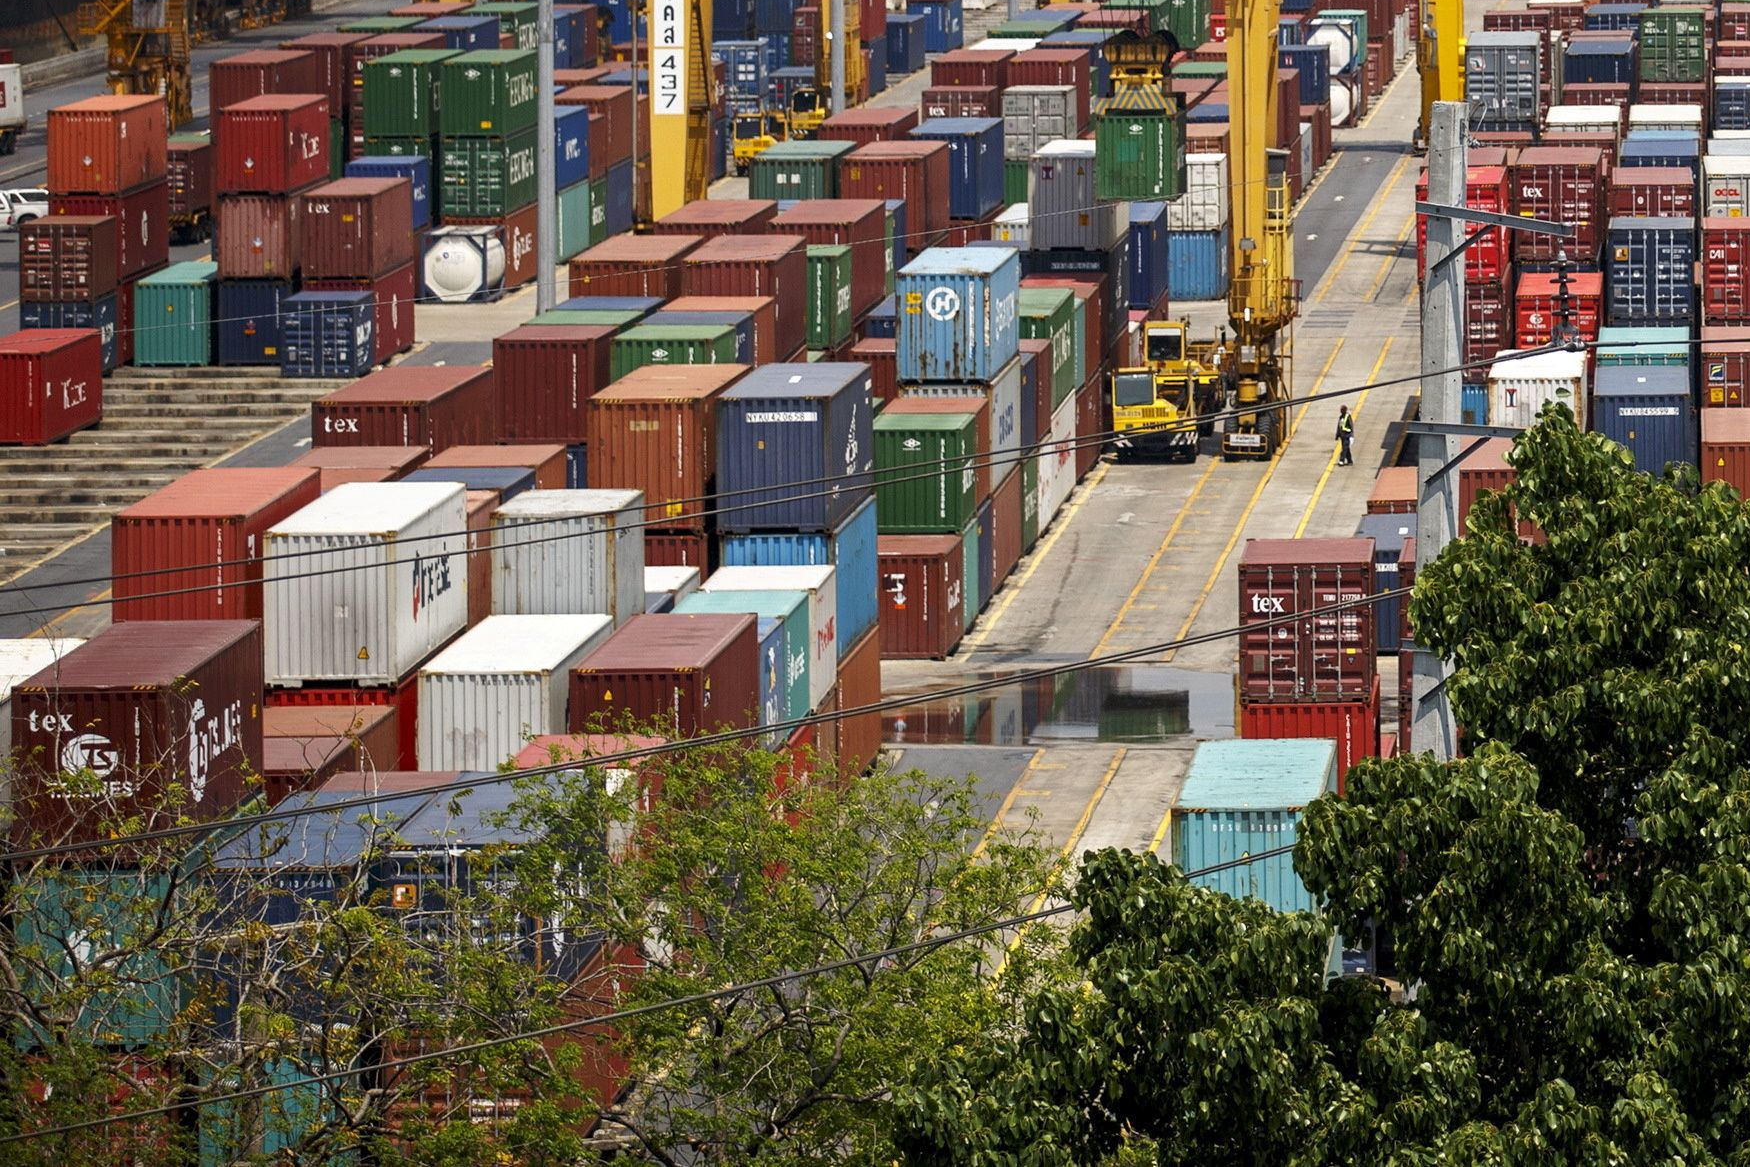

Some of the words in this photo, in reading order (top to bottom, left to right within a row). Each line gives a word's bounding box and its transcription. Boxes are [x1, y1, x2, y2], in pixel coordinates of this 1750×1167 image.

[661, 54, 678, 109] 437
[928, 106, 946, 116] tex
[1522, 185, 1544, 198] tex
[1714, 188, 1741, 197] OOCL
[308, 202, 331, 215] tex
[1709, 249, 1725, 259] CAI
[324, 415, 359, 433] tex
[1251, 593, 1285, 612] tex
[29, 708, 75, 733] tex
[1212, 823, 1241, 832] DFSU
